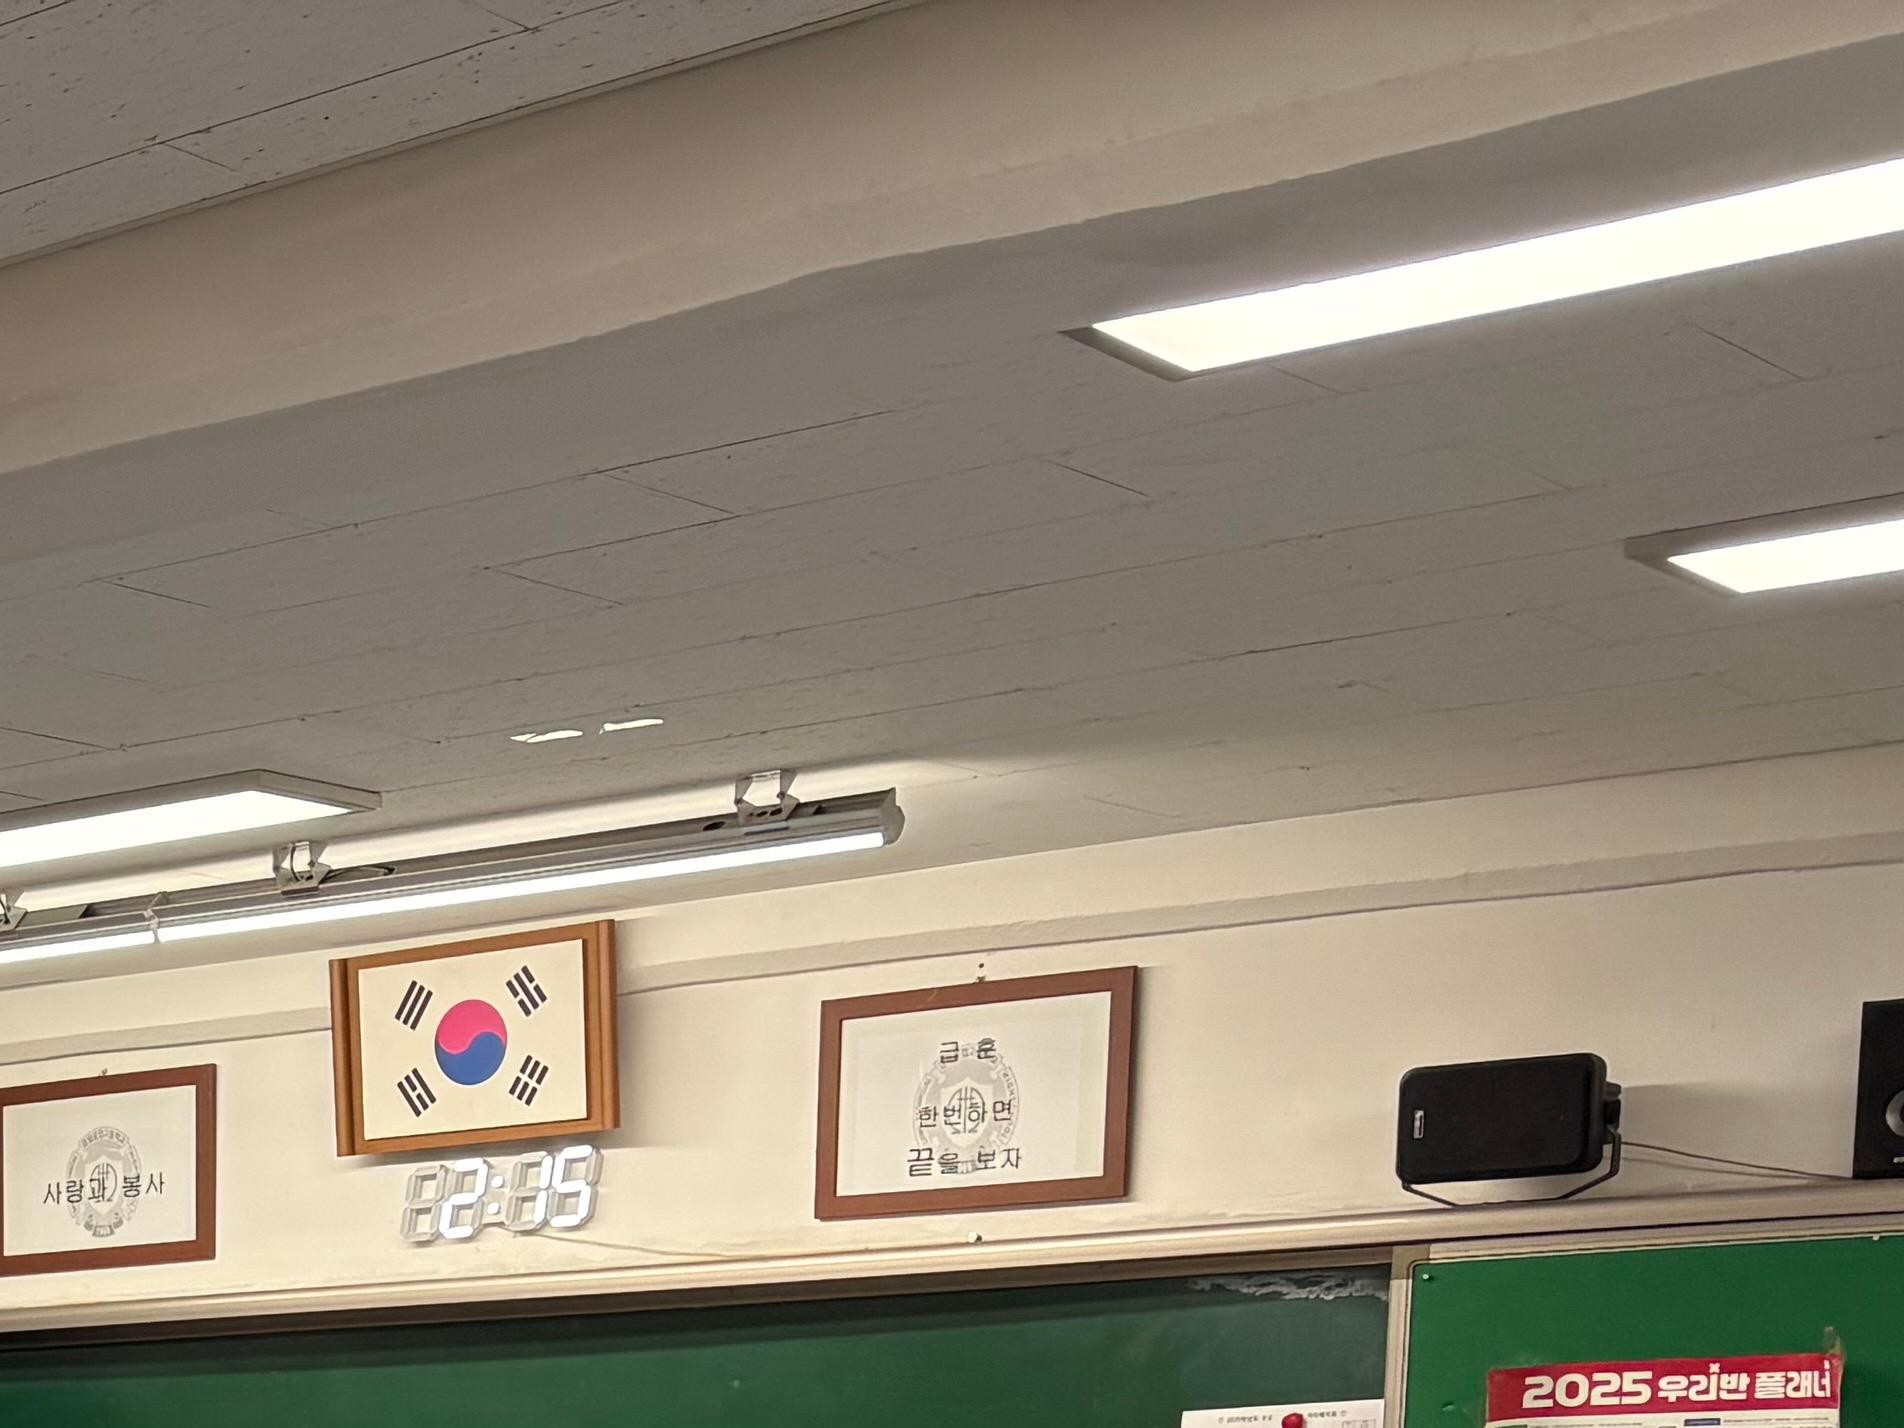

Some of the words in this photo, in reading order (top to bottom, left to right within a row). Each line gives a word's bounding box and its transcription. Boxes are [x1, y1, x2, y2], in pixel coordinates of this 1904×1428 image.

[907, 1147, 960, 1177] 끝을
[976, 1147, 1022, 1170] 보자
[43, 1179, 107, 1205] 사랑과
[122, 1171, 166, 1199] 봉사
[1522, 1371, 1653, 1409] 2025
[1657, 1362, 1750, 1402] 우리반
[1754, 1360, 1831, 1399] 플래너
